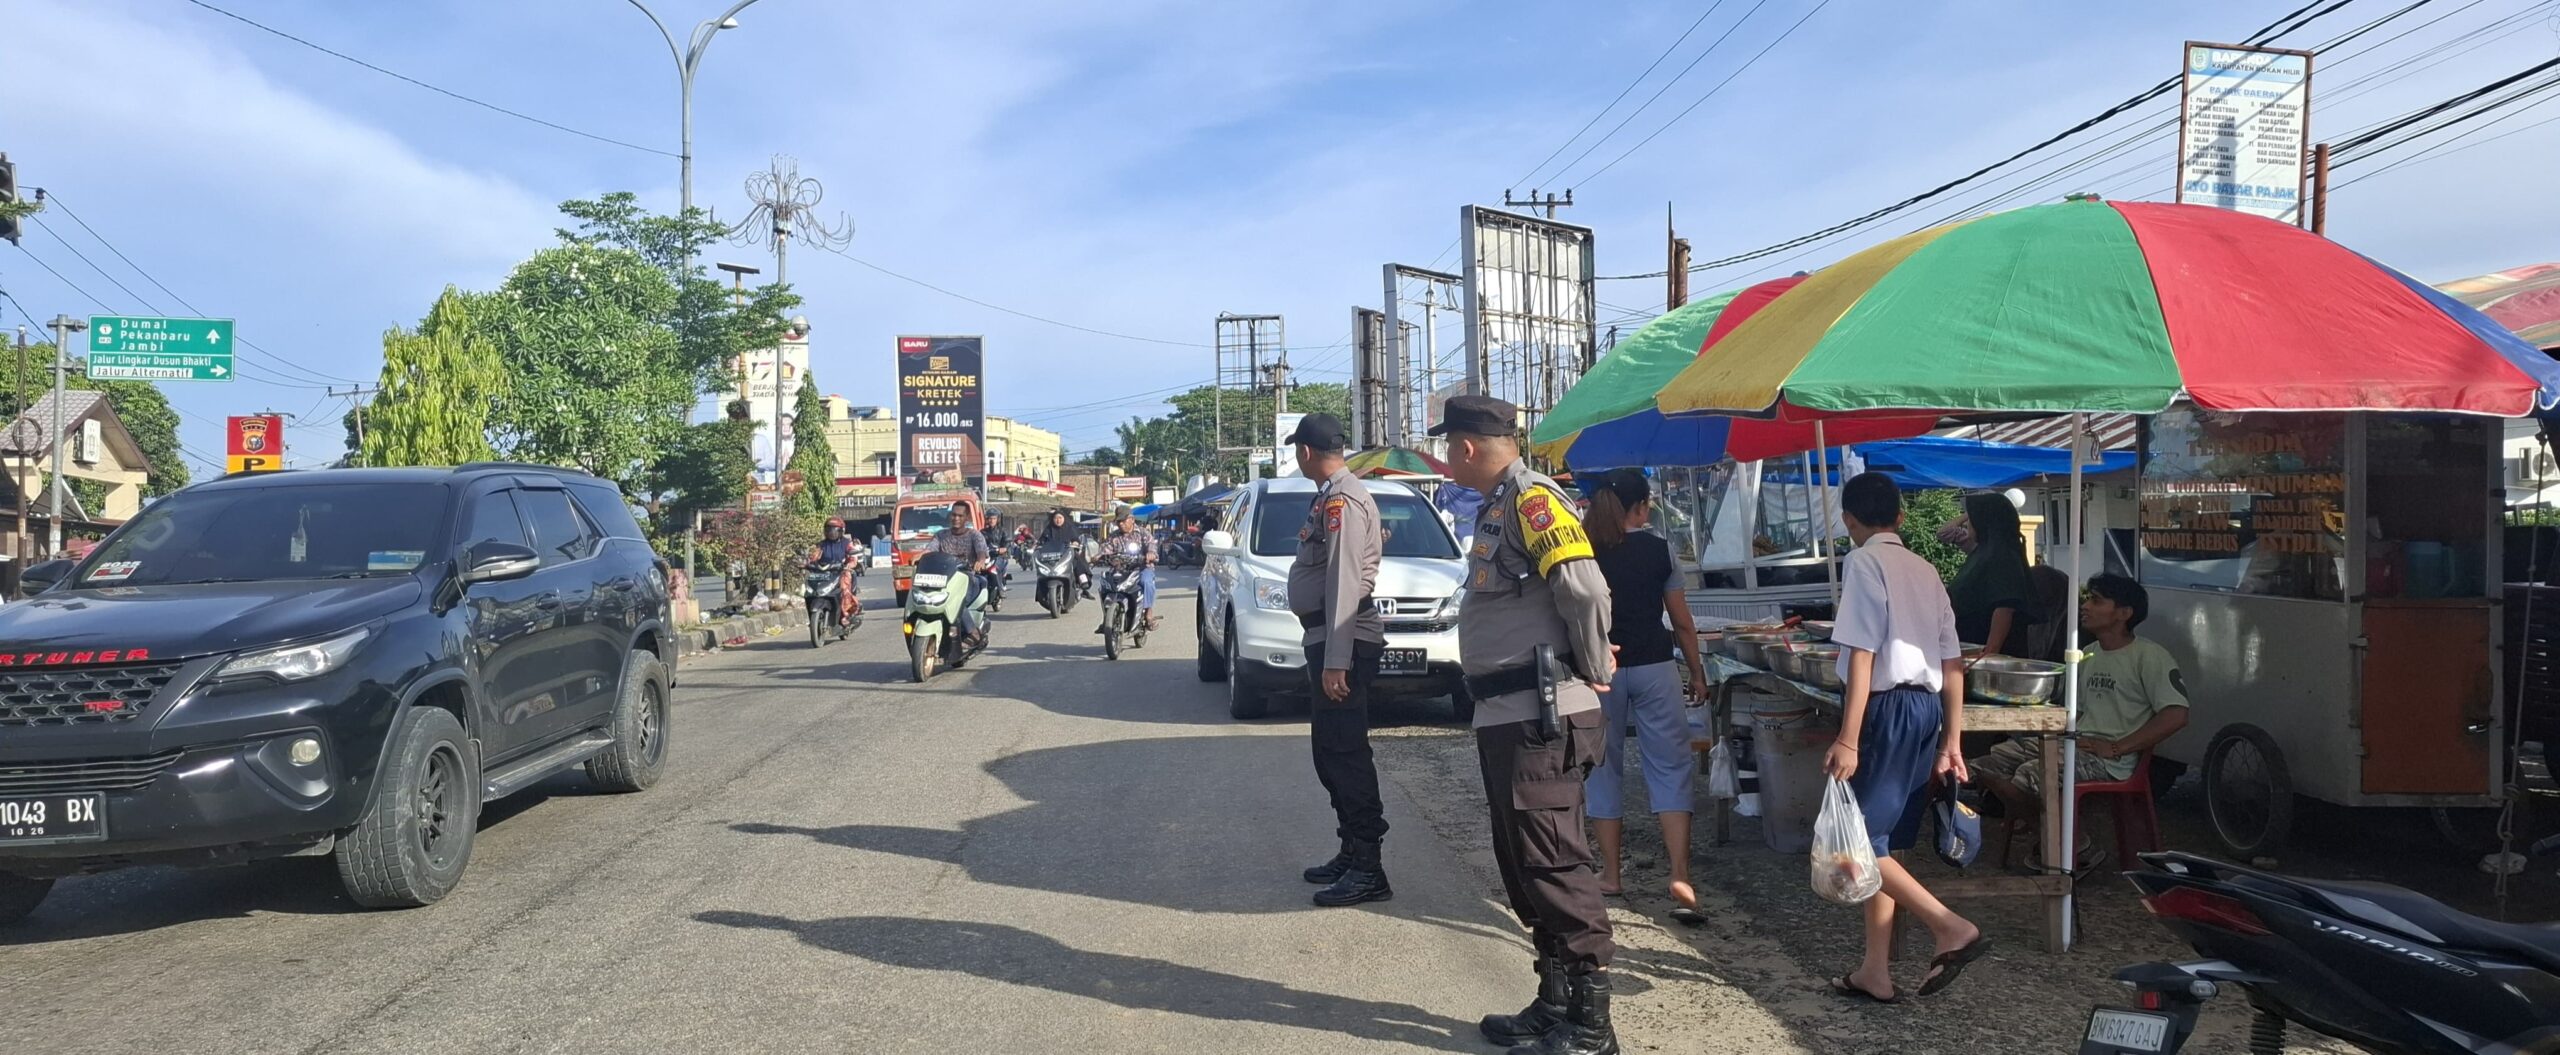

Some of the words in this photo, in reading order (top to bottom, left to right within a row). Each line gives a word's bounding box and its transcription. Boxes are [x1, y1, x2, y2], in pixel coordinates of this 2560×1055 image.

[2185, 180, 2209, 193] AYO
[2255, 186, 2296, 200] PAJAK
[120, 330, 190, 341] Pekanbaru
[120, 341, 164, 351] Jambi
[92, 355, 116, 364] Jalur
[117, 355, 151, 367] Lingkar
[153, 357, 181, 366] Dusun
[183, 357, 211, 366] Bhakti
[96, 366, 126, 376] Jalur
[131, 367, 189, 378] Alternatif
[903, 375, 976, 387] SIGNATURE
[917, 389, 962, 398] KRETEK
[906, 416, 914, 424] RP
[917, 412, 959, 427] 16.000
[919, 437, 961, 450] REVOLUSI
[920, 451, 962, 464] KRETEK
[244, 458, 265, 471] P
[2142, 532, 2194, 550] INDOMIE
[2195, 533, 2239, 552] REBUS
[67, 798, 95, 822] BX
[11, 828, 24, 836] 10
[2091, 1016, 2107, 1039] BM
[2107, 1018, 2136, 1044] 6347
[2135, 1022, 2162, 1047] GAJ
